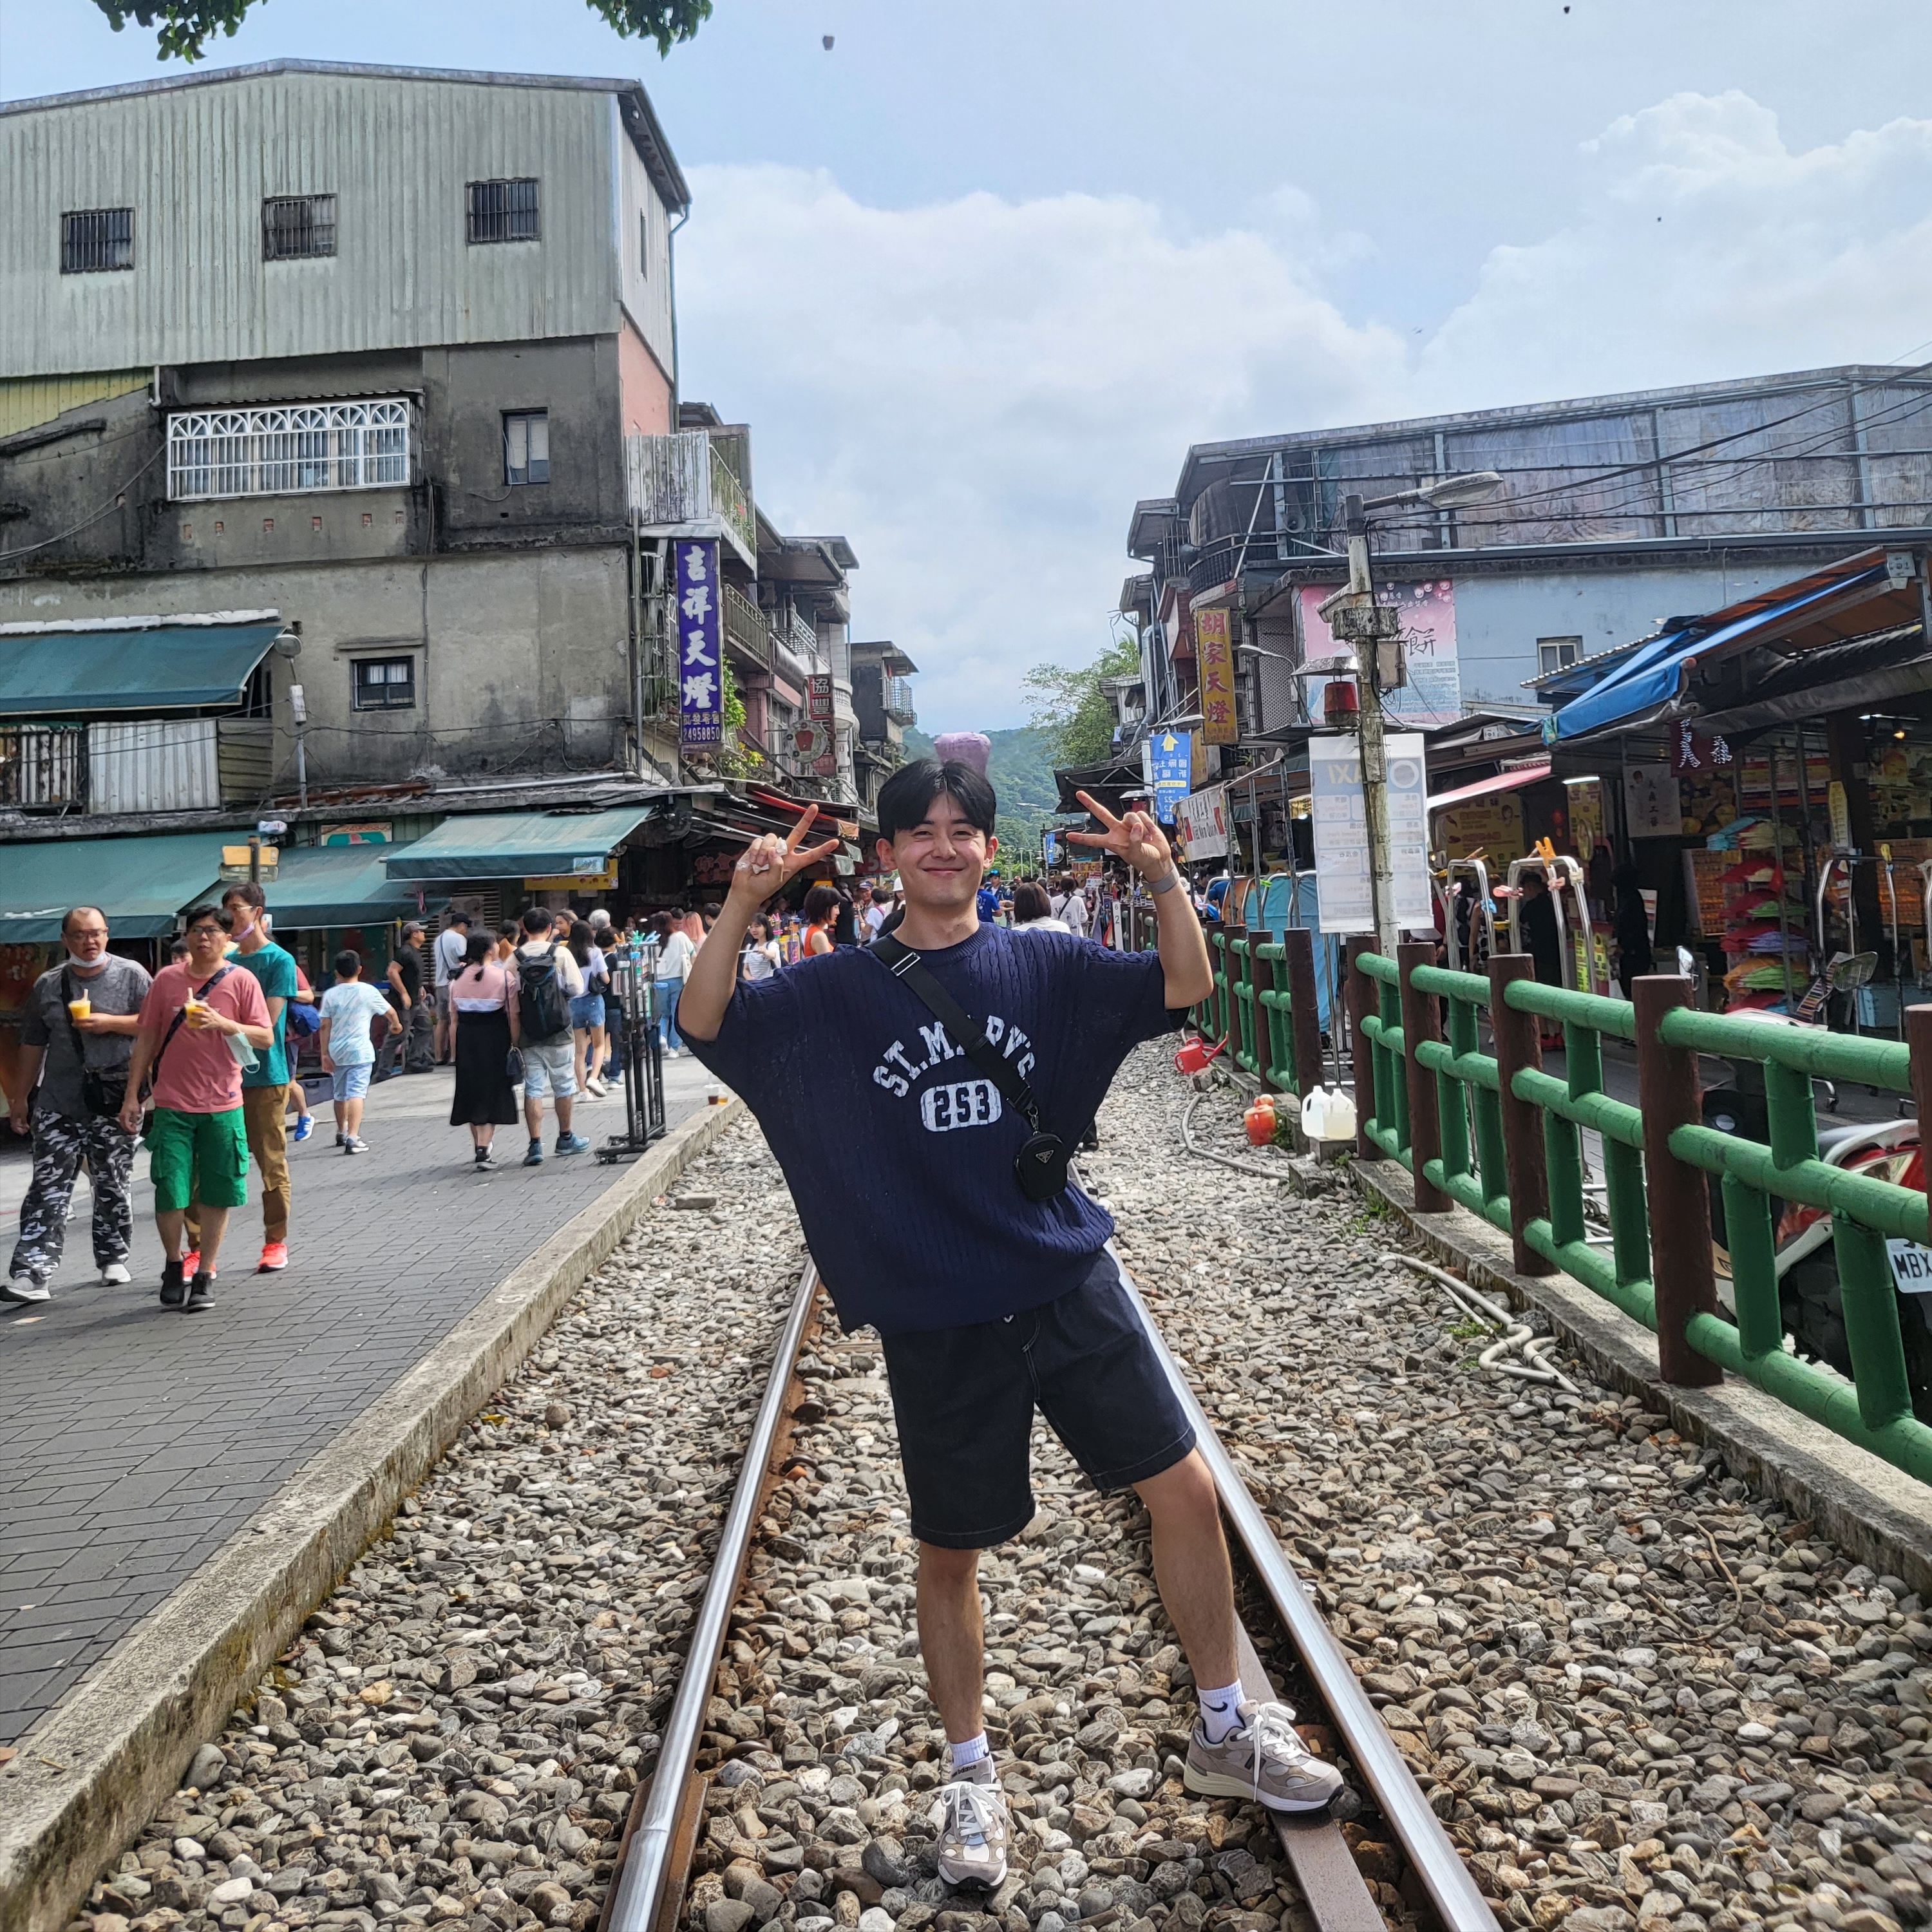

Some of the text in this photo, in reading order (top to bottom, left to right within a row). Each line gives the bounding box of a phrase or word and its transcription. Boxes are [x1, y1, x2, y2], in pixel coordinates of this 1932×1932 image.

[682, 545, 717, 709] 吉祥天燈
[1201, 612, 1231, 724] 胡家天燈
[683, 726, 721, 742] 24958850
[1115, 915, 1120, 924] 2
